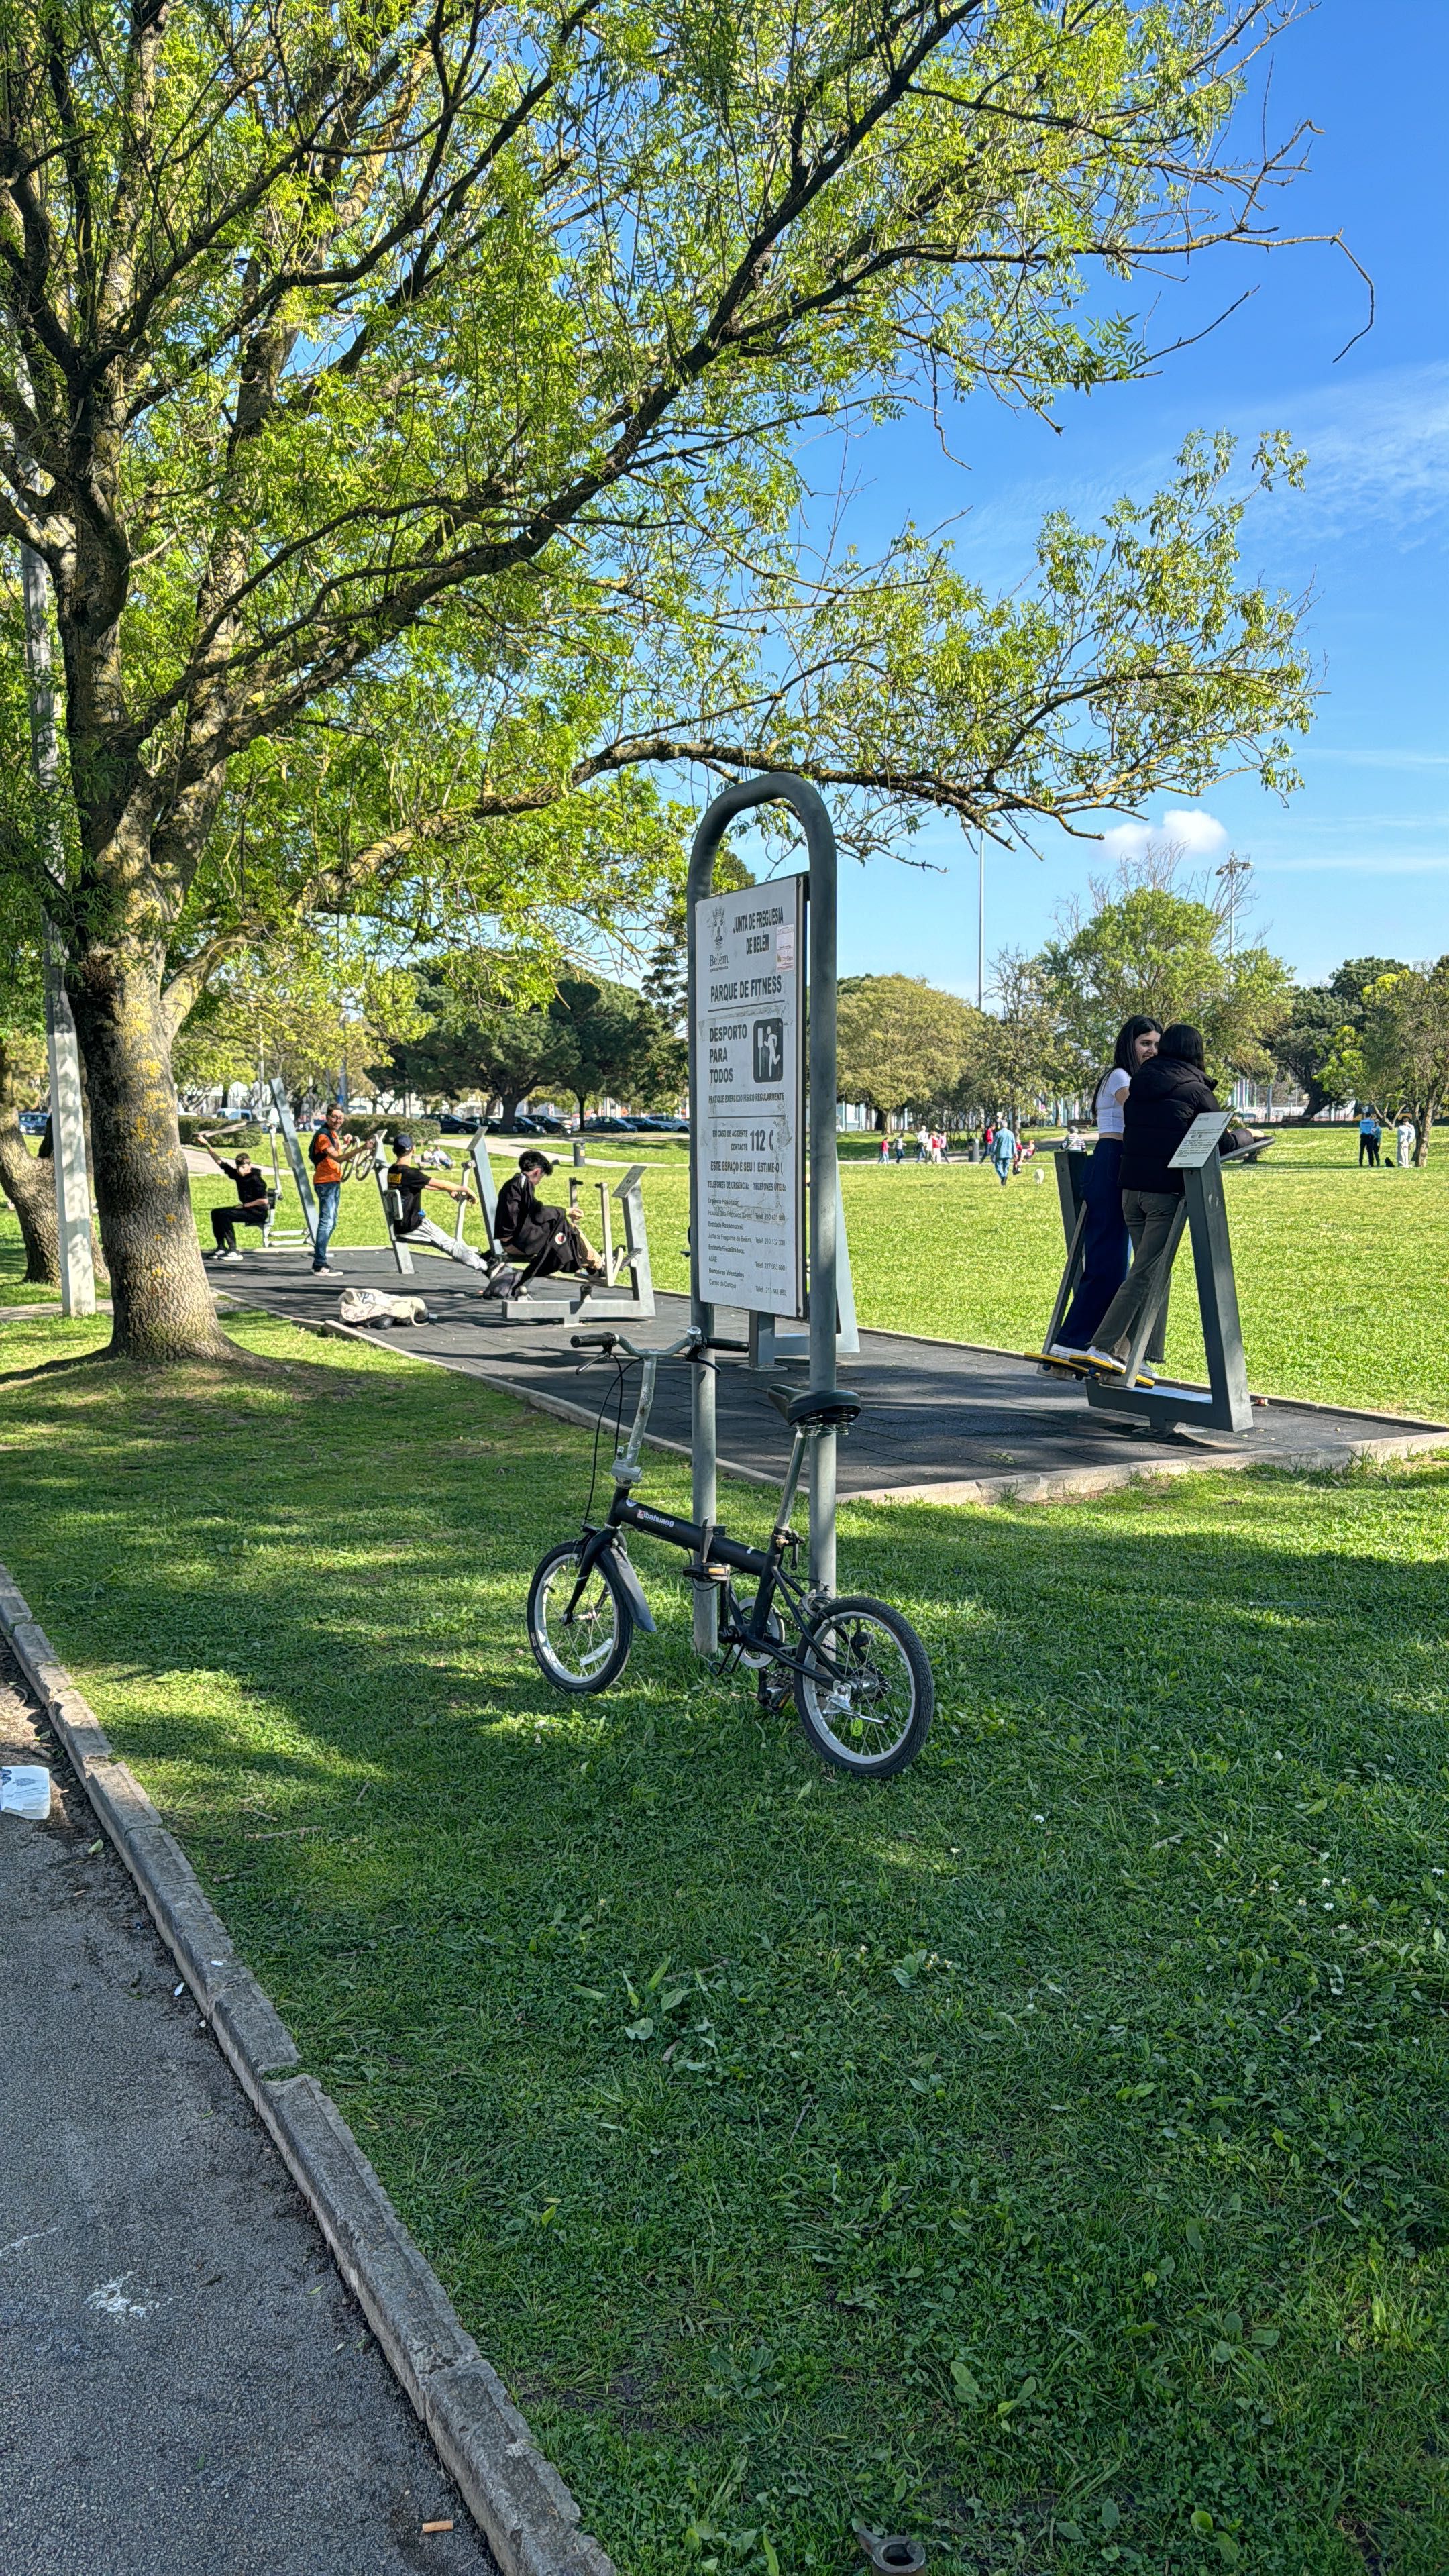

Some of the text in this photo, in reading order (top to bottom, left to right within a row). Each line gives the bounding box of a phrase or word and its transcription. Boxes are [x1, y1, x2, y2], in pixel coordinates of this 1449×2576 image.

[733, 906, 784, 934] JUNTA DE FREGUESIA
[746, 930, 769, 955] DE BELÉM
[710, 953, 729, 967] Belém
[711, 975, 782, 1002] PARQUE DE FITNESS
[710, 1024, 747, 1042] DESPORTO
[710, 1047, 728, 1063] PARA
[709, 1068, 733, 1083] TODOS
[708, 1095, 724, 1104] PRATIQUE
[755, 1092, 784, 1102] REGULARMENTE
[750, 1130, 765, 1151] 112
[710, 1161, 721, 1171] ESTE
[722, 1161, 739, 1174] ESPAÇO
[739, 1159, 743, 1172] É
[743, 1162, 752, 1172] SEU
[757, 1162, 780, 1173] ESTIME-O
[708, 1181, 725, 1189] TELEFONES
[753, 1182, 773, 1191] TELEFONES
